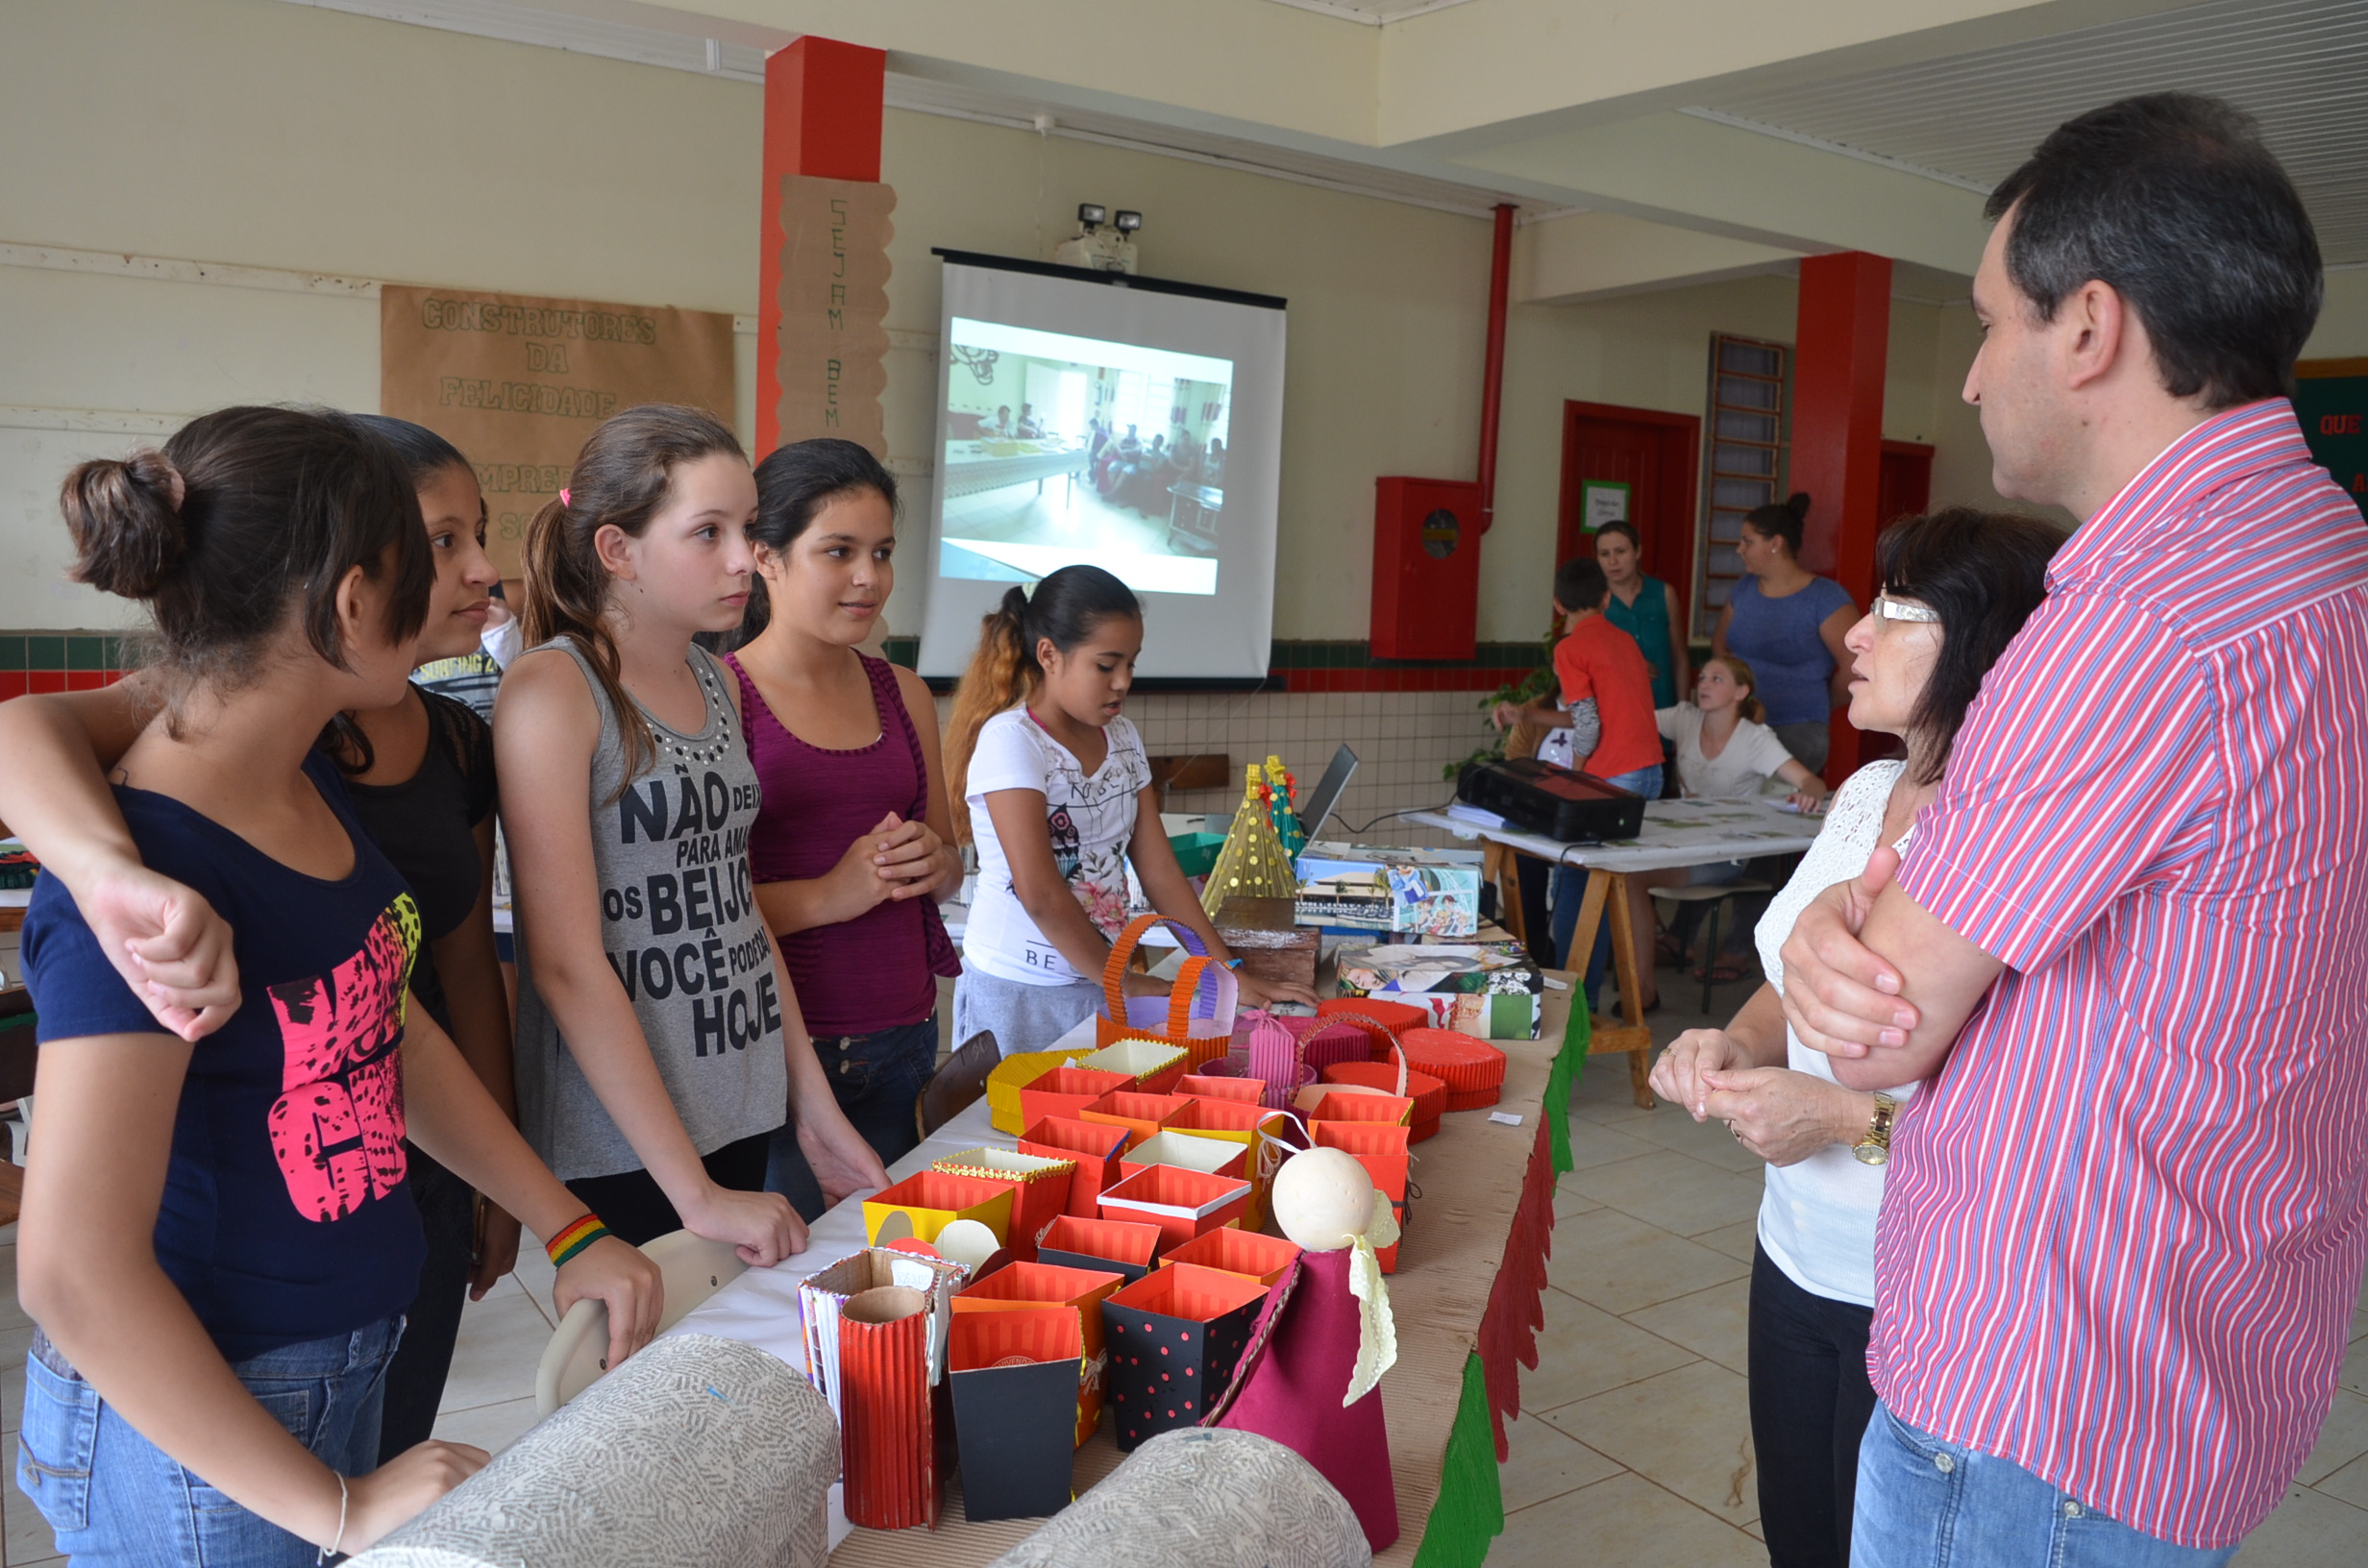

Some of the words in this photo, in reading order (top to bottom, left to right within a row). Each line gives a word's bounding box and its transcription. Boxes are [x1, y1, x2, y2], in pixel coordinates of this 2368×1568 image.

[827, 198, 848, 331] SEJAM
[422, 298, 656, 345] CONSTRUTORES
[526, 342, 569, 374] DA
[439, 377, 616, 421] FELICIDADE
[825, 358, 842, 429] BEM
[2319, 414, 2362, 436] QUE
[418, 654, 482, 681] SURFING
[618, 763, 730, 845] NÃO
[676, 834, 721, 869] PARA
[603, 886, 644, 922] OS
[646, 856, 754, 936] BEIJO
[605, 926, 730, 1003] VOCÊ
[753, 925, 772, 962] DA
[692, 971, 782, 1058] HOJE
